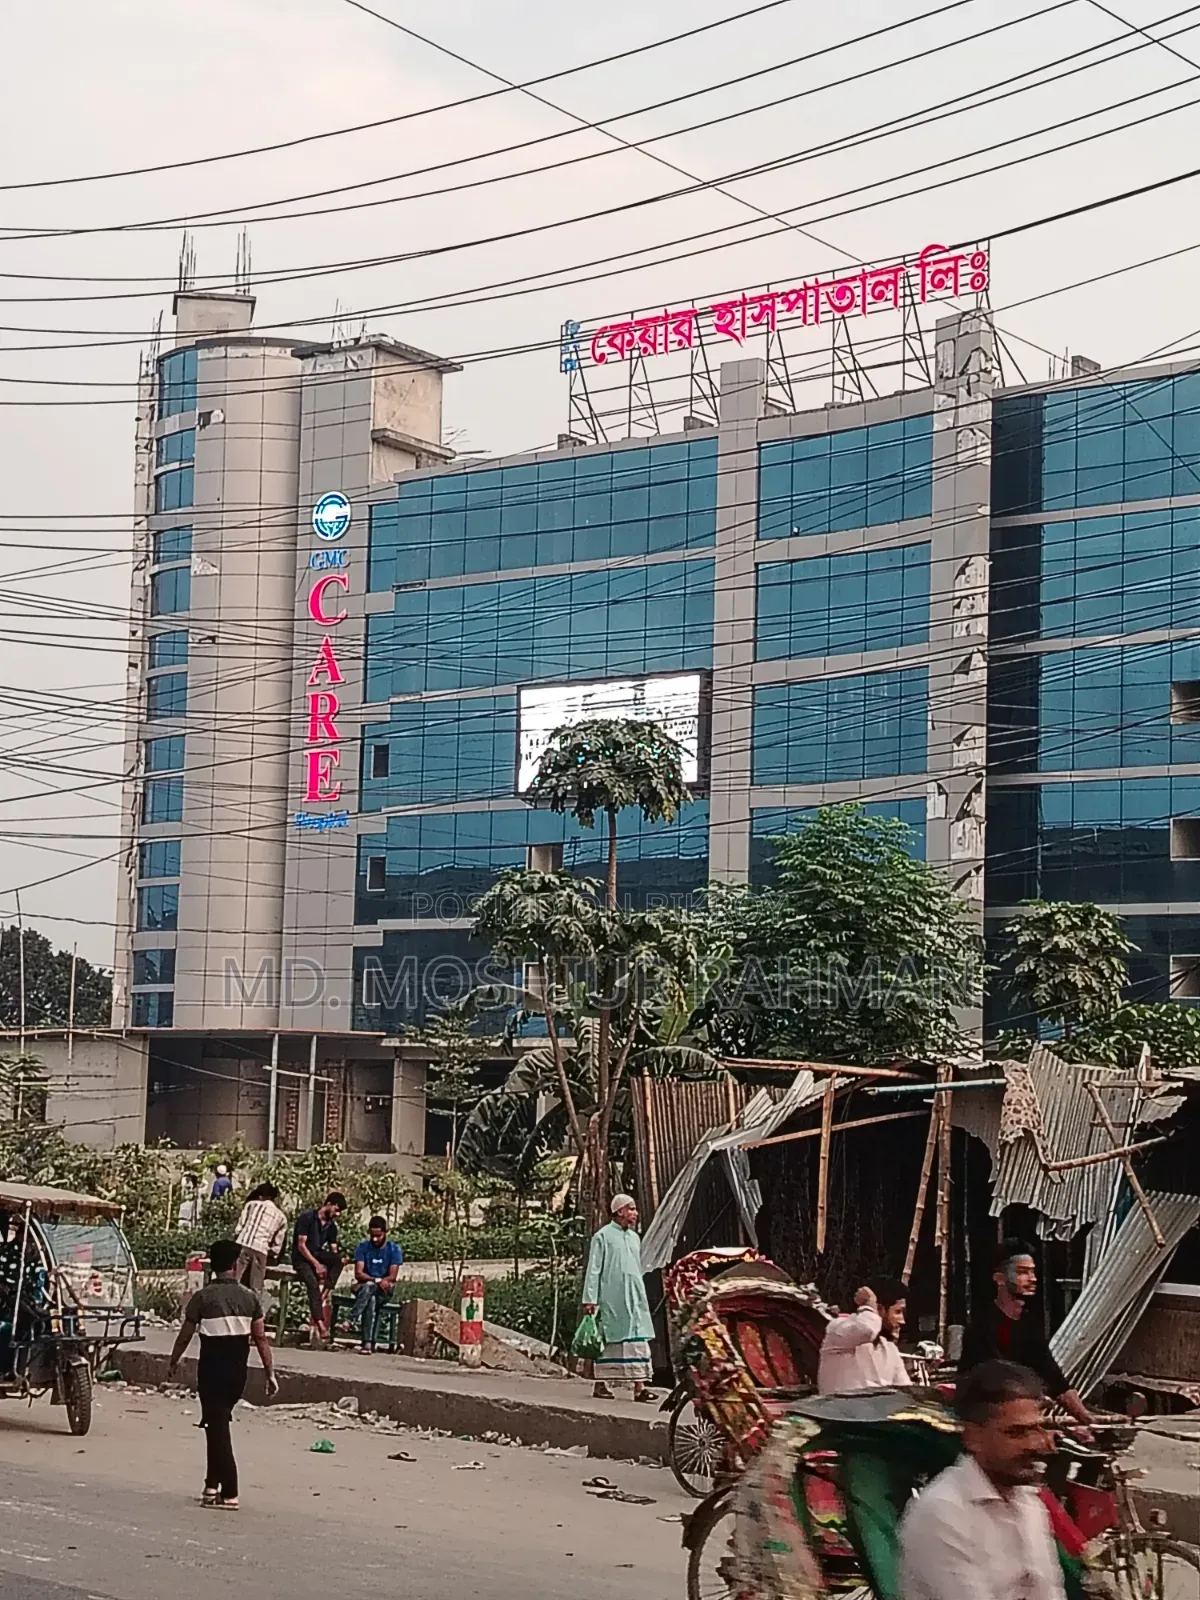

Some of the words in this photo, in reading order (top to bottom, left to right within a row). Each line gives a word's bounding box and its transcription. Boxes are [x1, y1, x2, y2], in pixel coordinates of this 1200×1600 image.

[590, 307, 698, 365] কেয়ার
[710, 264, 907, 347] হাসপাতাল
[310, 550, 351, 571] GMC
[302, 573, 350, 803] CARE
